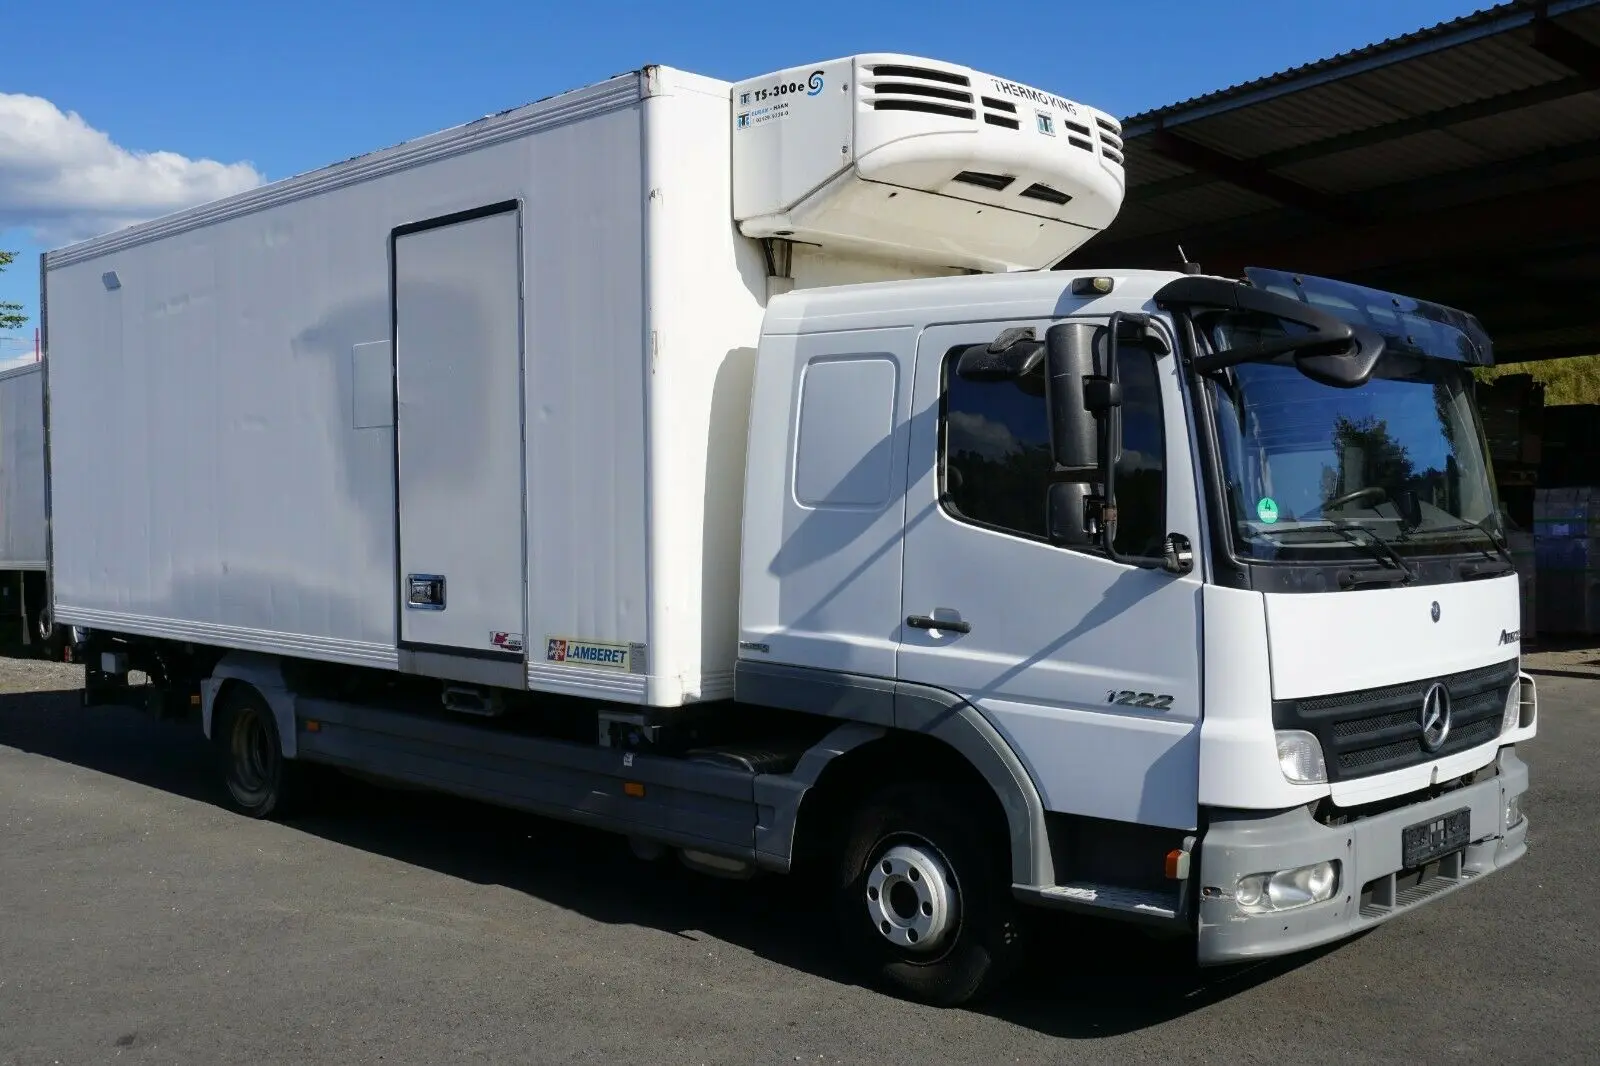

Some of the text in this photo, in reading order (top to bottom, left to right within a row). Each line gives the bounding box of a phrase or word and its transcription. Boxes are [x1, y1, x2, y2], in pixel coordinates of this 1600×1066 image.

[754, 83, 805, 102] TS-300e
[991, 79, 1077, 116] THERMO KING
[1265, 499, 1271, 511] 4
[566, 645, 627, 663] LAMBERET
[1107, 690, 1175, 711] 1222
